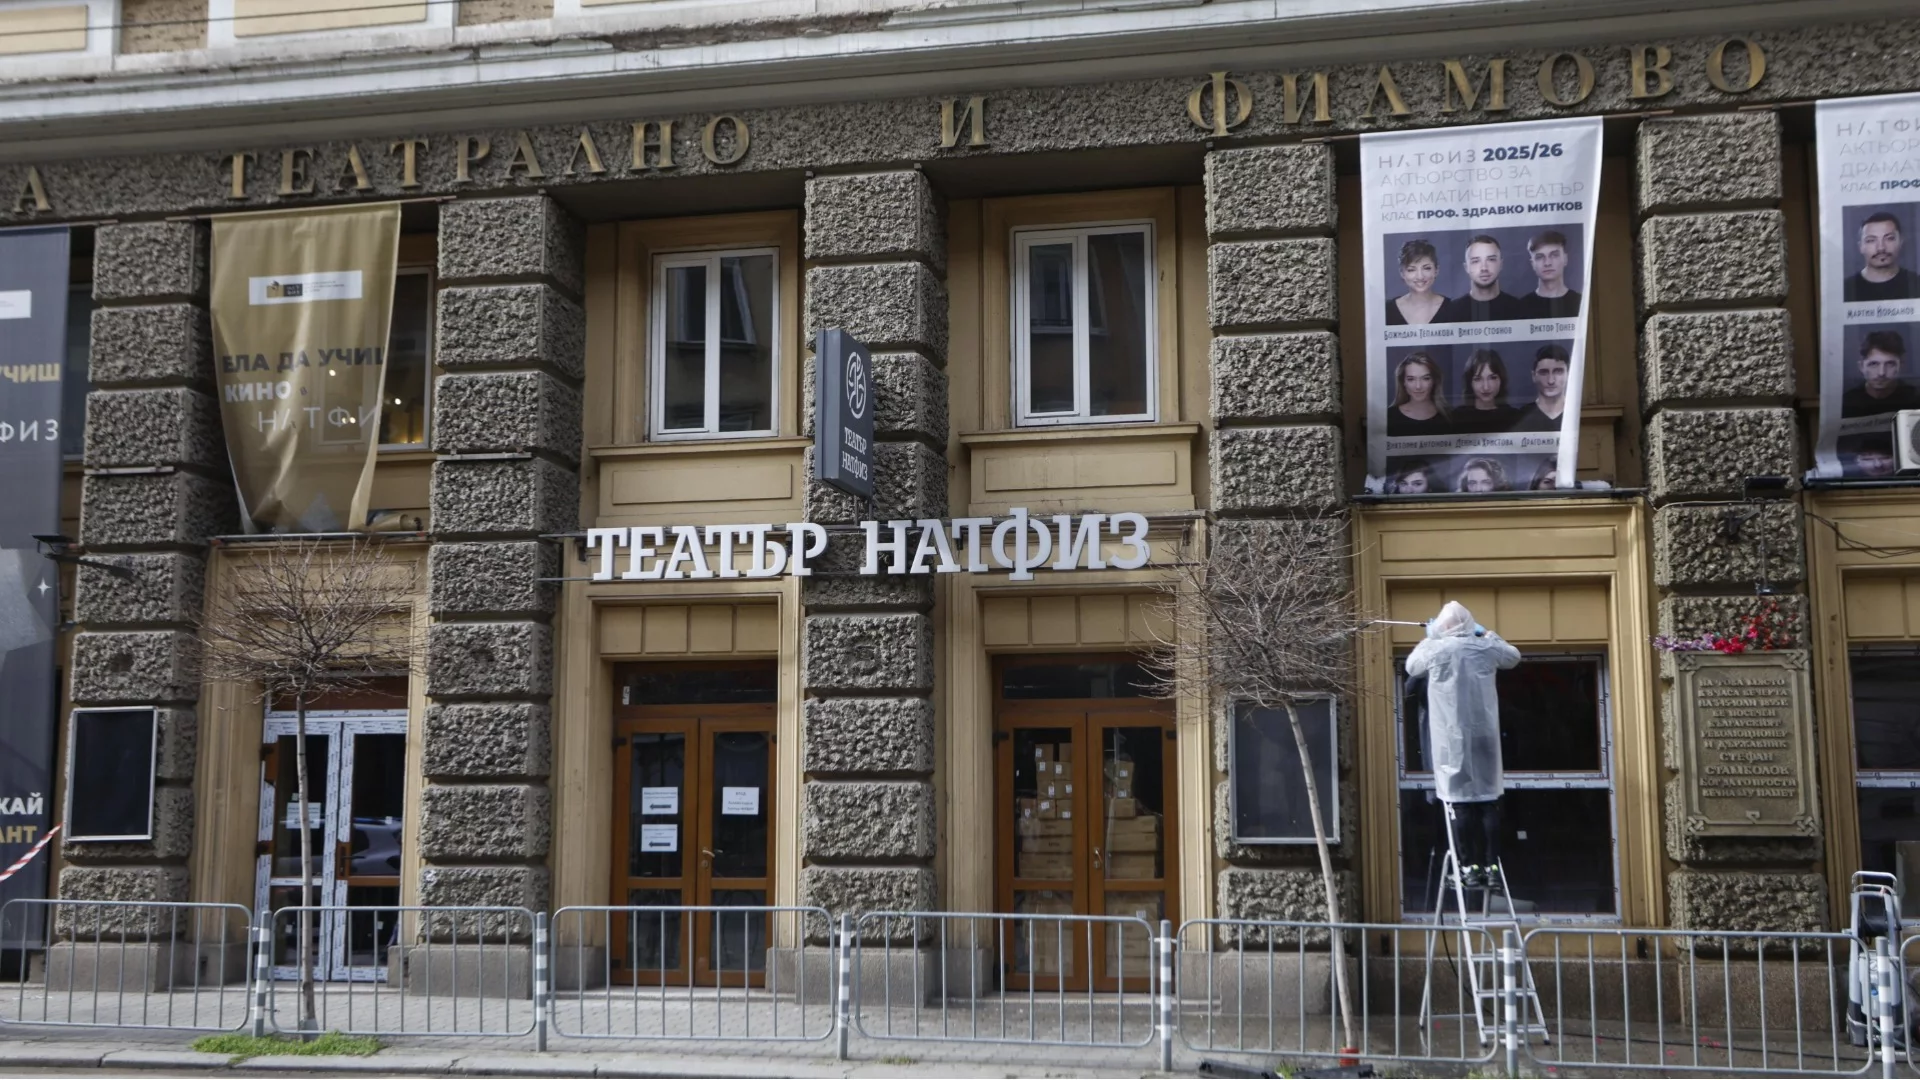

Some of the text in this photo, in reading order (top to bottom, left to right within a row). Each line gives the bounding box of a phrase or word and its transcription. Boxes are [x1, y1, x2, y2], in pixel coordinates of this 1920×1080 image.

[218, 115, 751, 199] ТЕАТРАЛНО
[938, 96, 989, 149] И
[1188, 38, 1767, 137] ФИЛМОВО
[1483, 142, 1563, 162] 2025/26
[1508, 165, 1532, 179] ЗА
[1380, 181, 1585, 209] ДРАМАТИЧЕН ТЕАТЪР
[1841, 181, 1877, 192] КЛАС
[1381, 201, 1583, 222] КЛАС ПРОФ. ЗДРАВКО МИТКОВ
[222, 354, 270, 373] ЕЛА
[277, 350, 310, 373] ДА
[0, 363, 61, 383] ЧИШ
[224, 381, 292, 403] КИНО
[844, 426, 867, 455] ТЕАТЪР
[842, 450, 868, 481] НАТФИЗ
[586, 507, 1151, 581] ТЕАТЪР НАТФИЗ
[1720, 752, 1773, 763] СТЕФАН
[1705, 765, 1789, 775] СТАМБОЛОВ
